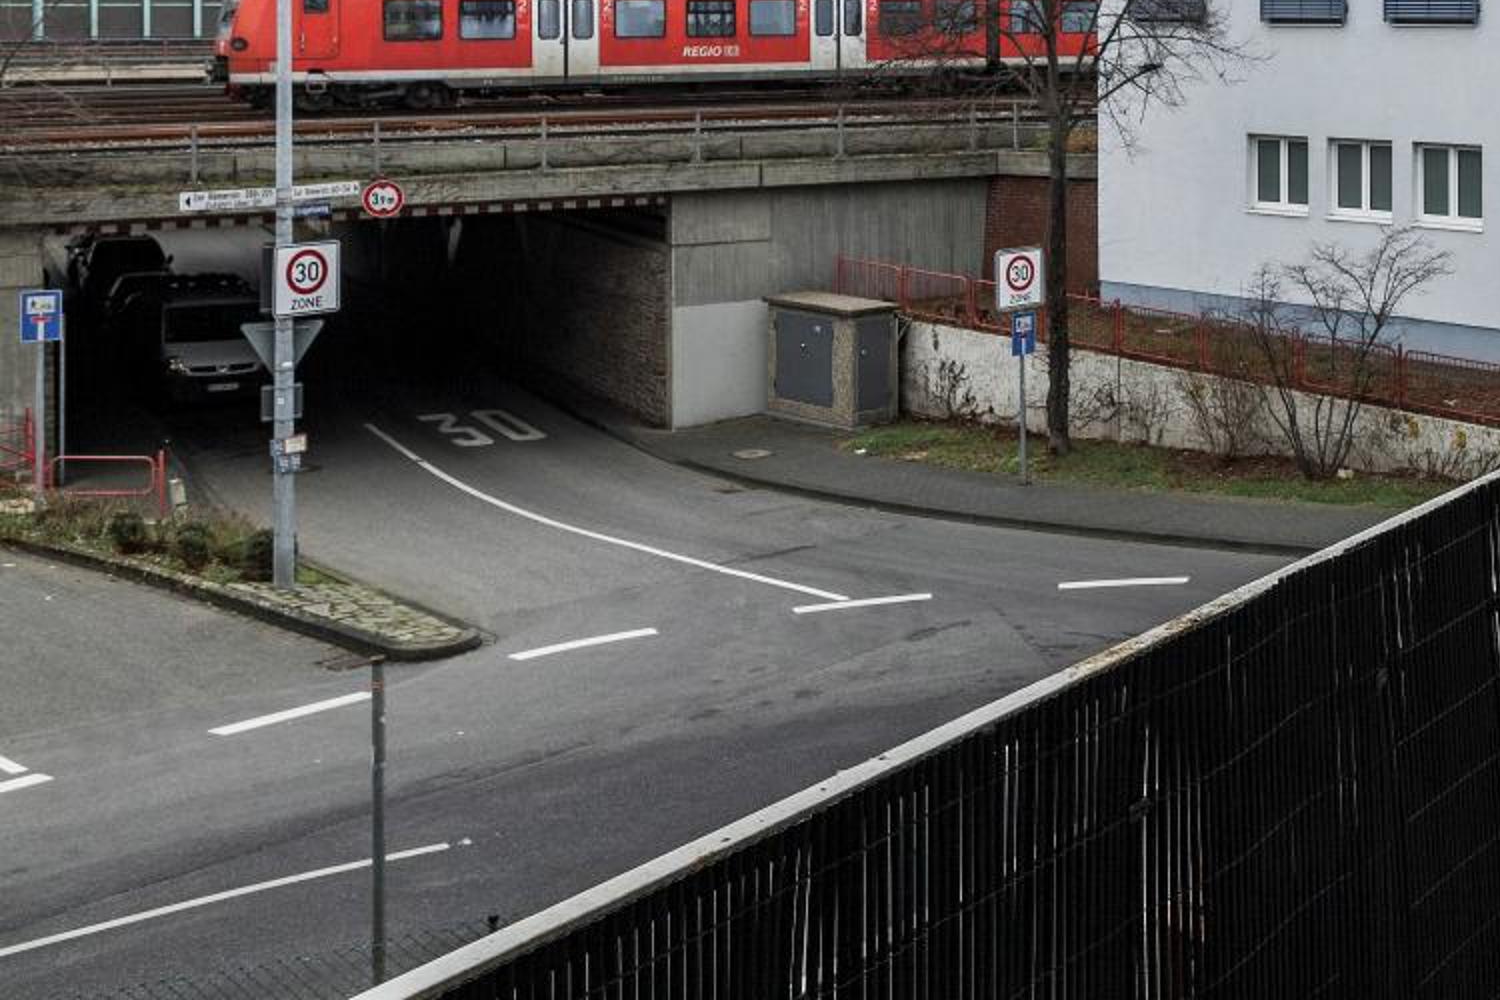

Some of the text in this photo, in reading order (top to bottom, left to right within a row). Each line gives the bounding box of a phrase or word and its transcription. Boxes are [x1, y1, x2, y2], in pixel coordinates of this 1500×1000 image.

[683, 45, 722, 57] REGIO
[295, 261, 319, 283] 30
[1011, 264, 1029, 283] 30
[290, 296, 322, 310] ZONE
[416, 409, 548, 447] 30
